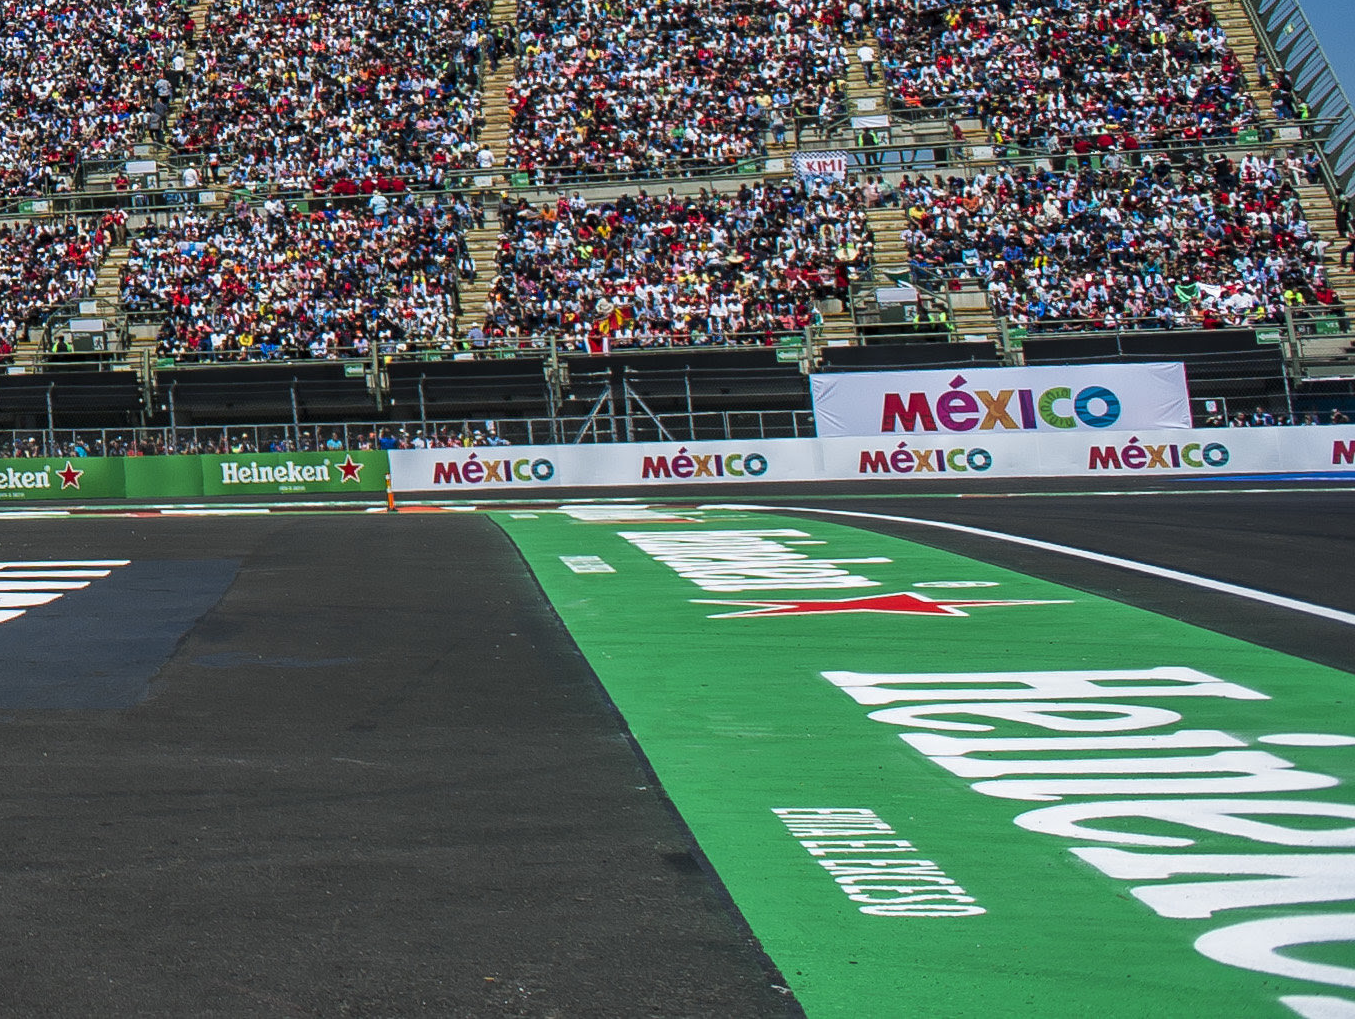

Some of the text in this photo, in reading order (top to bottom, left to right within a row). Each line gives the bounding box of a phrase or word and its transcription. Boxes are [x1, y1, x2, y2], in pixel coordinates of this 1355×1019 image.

[806, 159, 842, 173] KIMI
[220, 461, 329, 483] Heineken
[617, 529, 893, 591] Heineken
[770, 808, 987, 917] EVITA EL EXCESO
[820, 666, 1355, 1019] Heine
